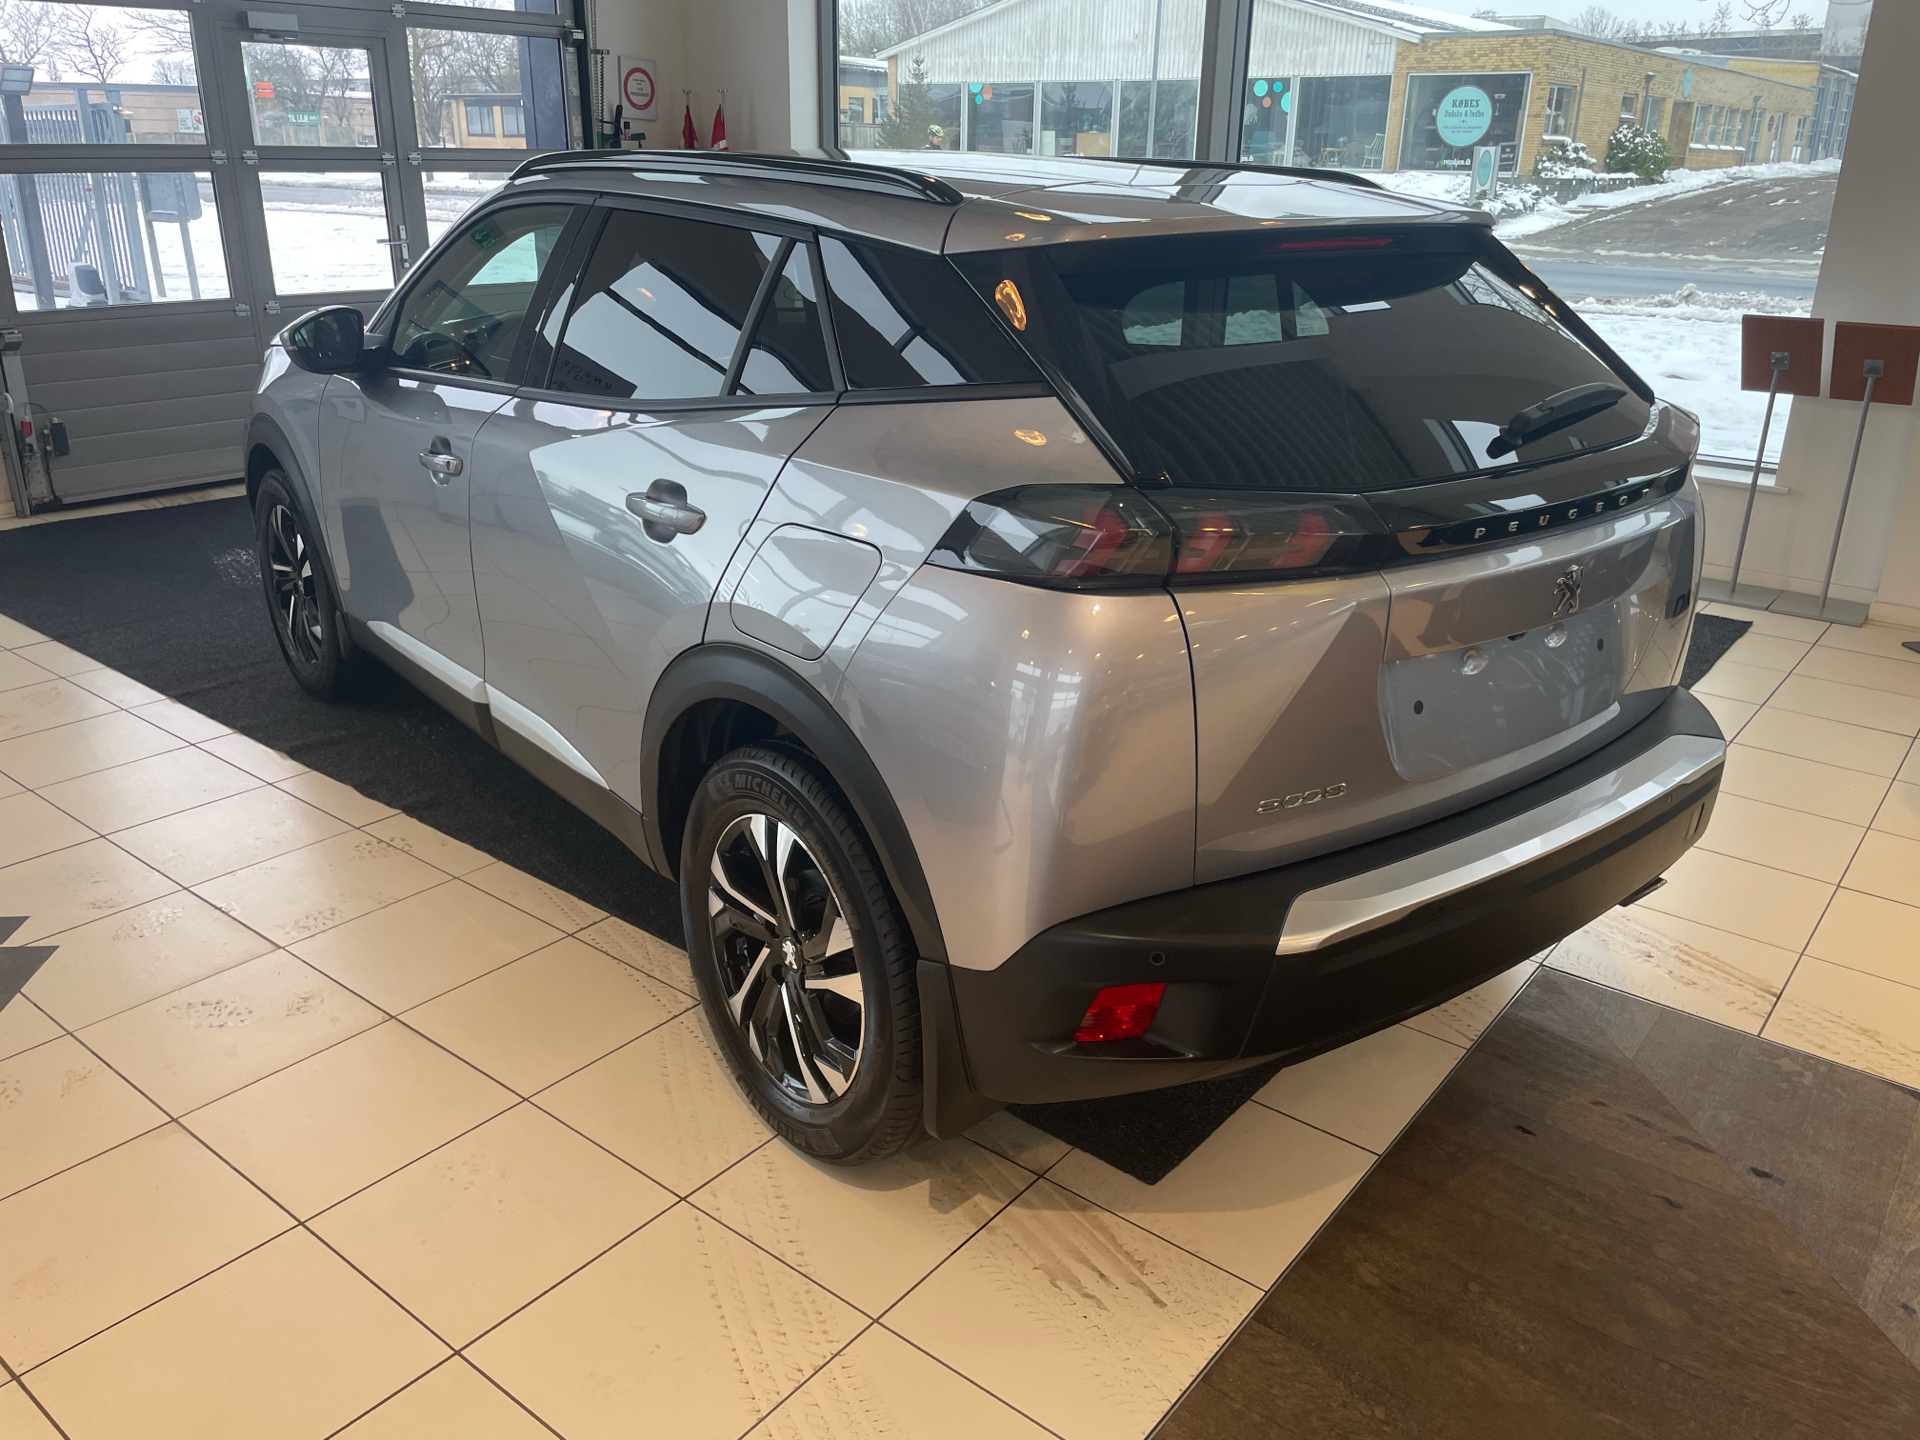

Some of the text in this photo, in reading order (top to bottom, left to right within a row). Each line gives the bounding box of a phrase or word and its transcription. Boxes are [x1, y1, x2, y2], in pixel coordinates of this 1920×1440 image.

[288, 114, 296, 122] TIL
[297, 114, 309, 123] LEJE
[1451, 99, 1480, 108] KØBES
[1473, 488, 1650, 539] PEUGEOT
[734, 773, 807, 831] MICHELIN
[1255, 782, 1347, 815] 2008
